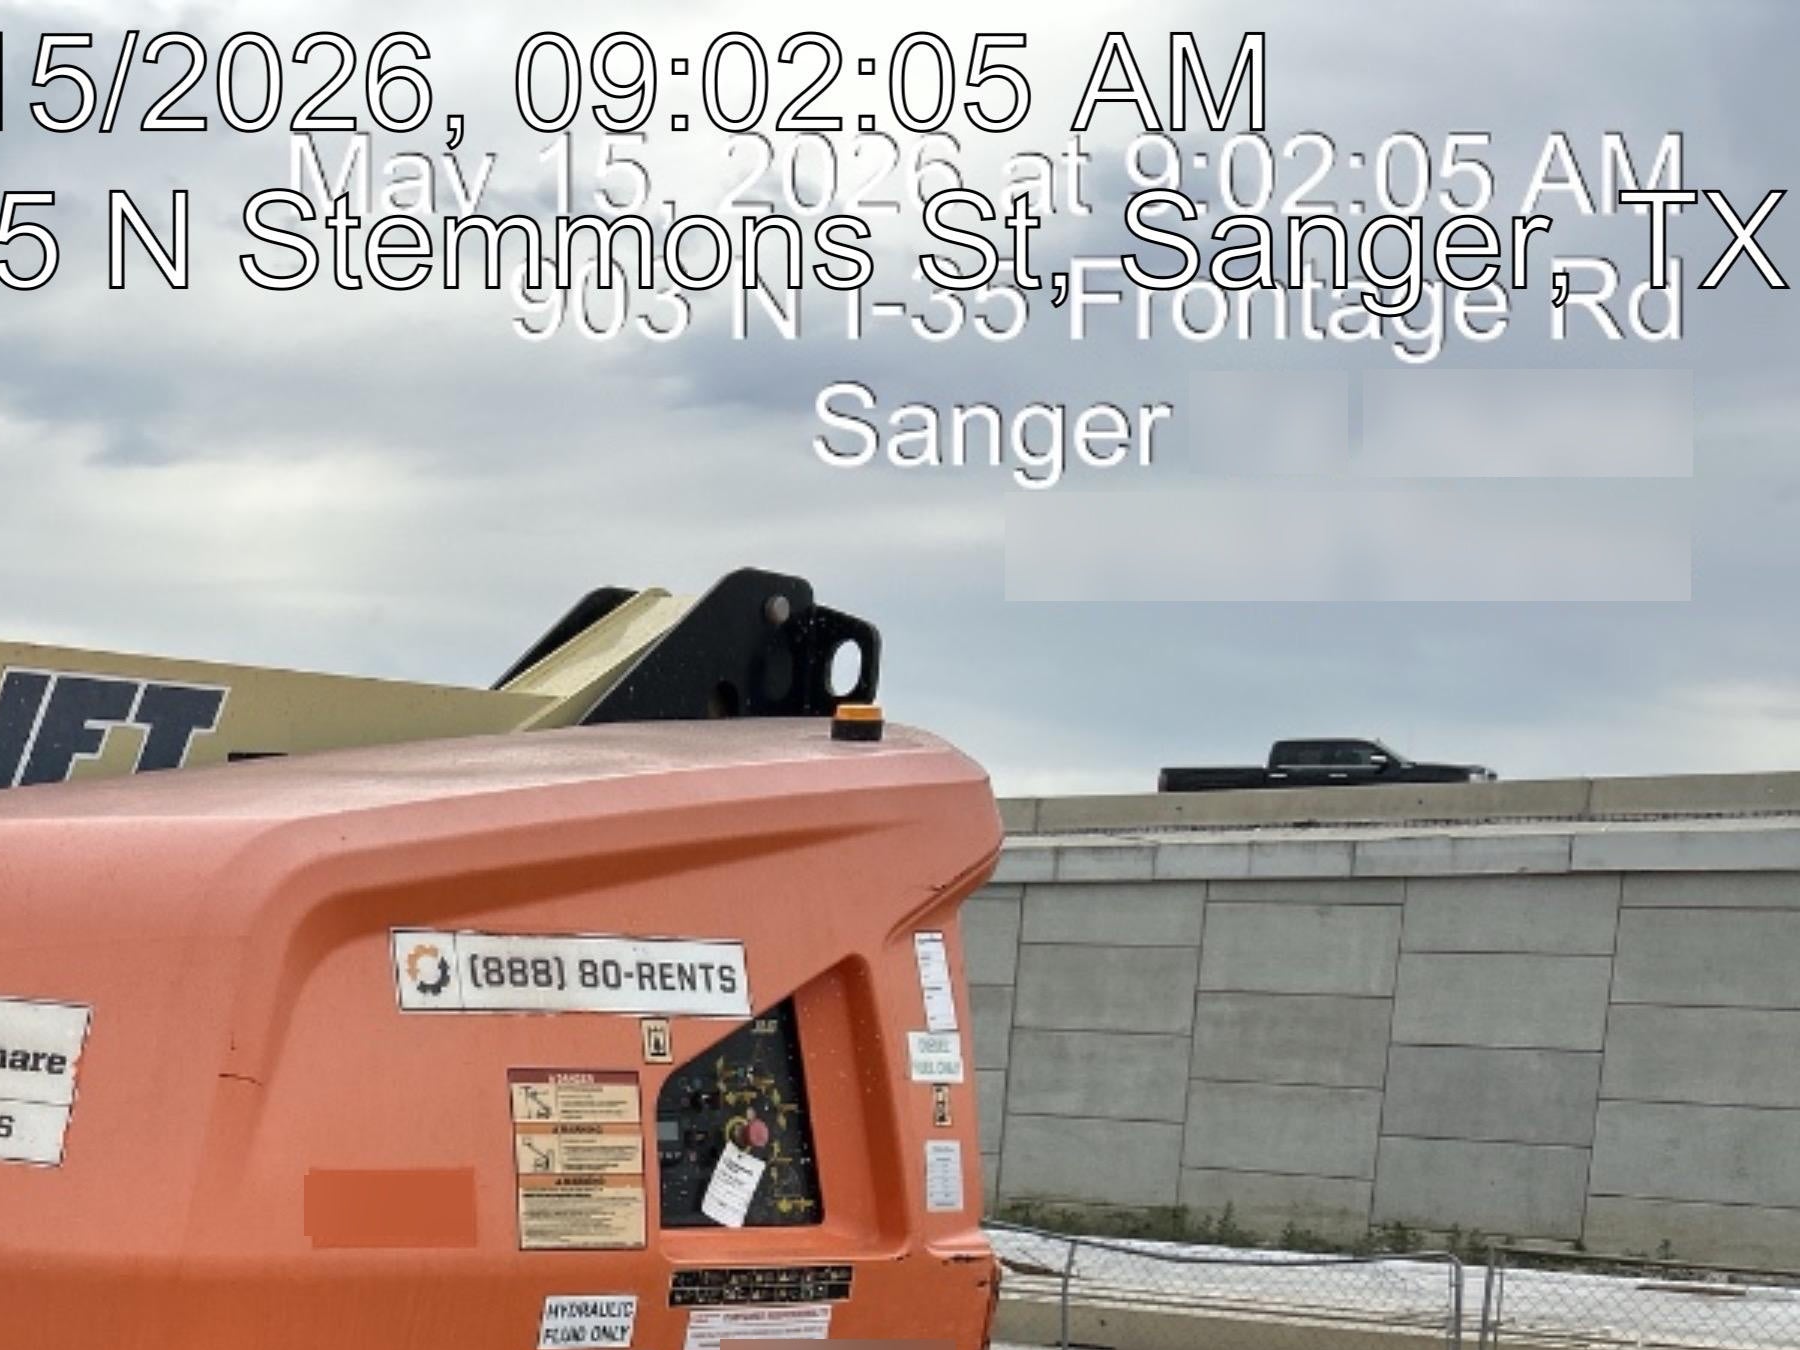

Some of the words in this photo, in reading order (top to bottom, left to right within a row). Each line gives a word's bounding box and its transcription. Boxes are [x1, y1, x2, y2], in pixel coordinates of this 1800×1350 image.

[469, 953, 566, 992] (888)
[578, 958, 738, 995] 80-RENTS
[547, 1301, 634, 1320] HYDRAULIC
[591, 1324, 630, 1342] ONLY
